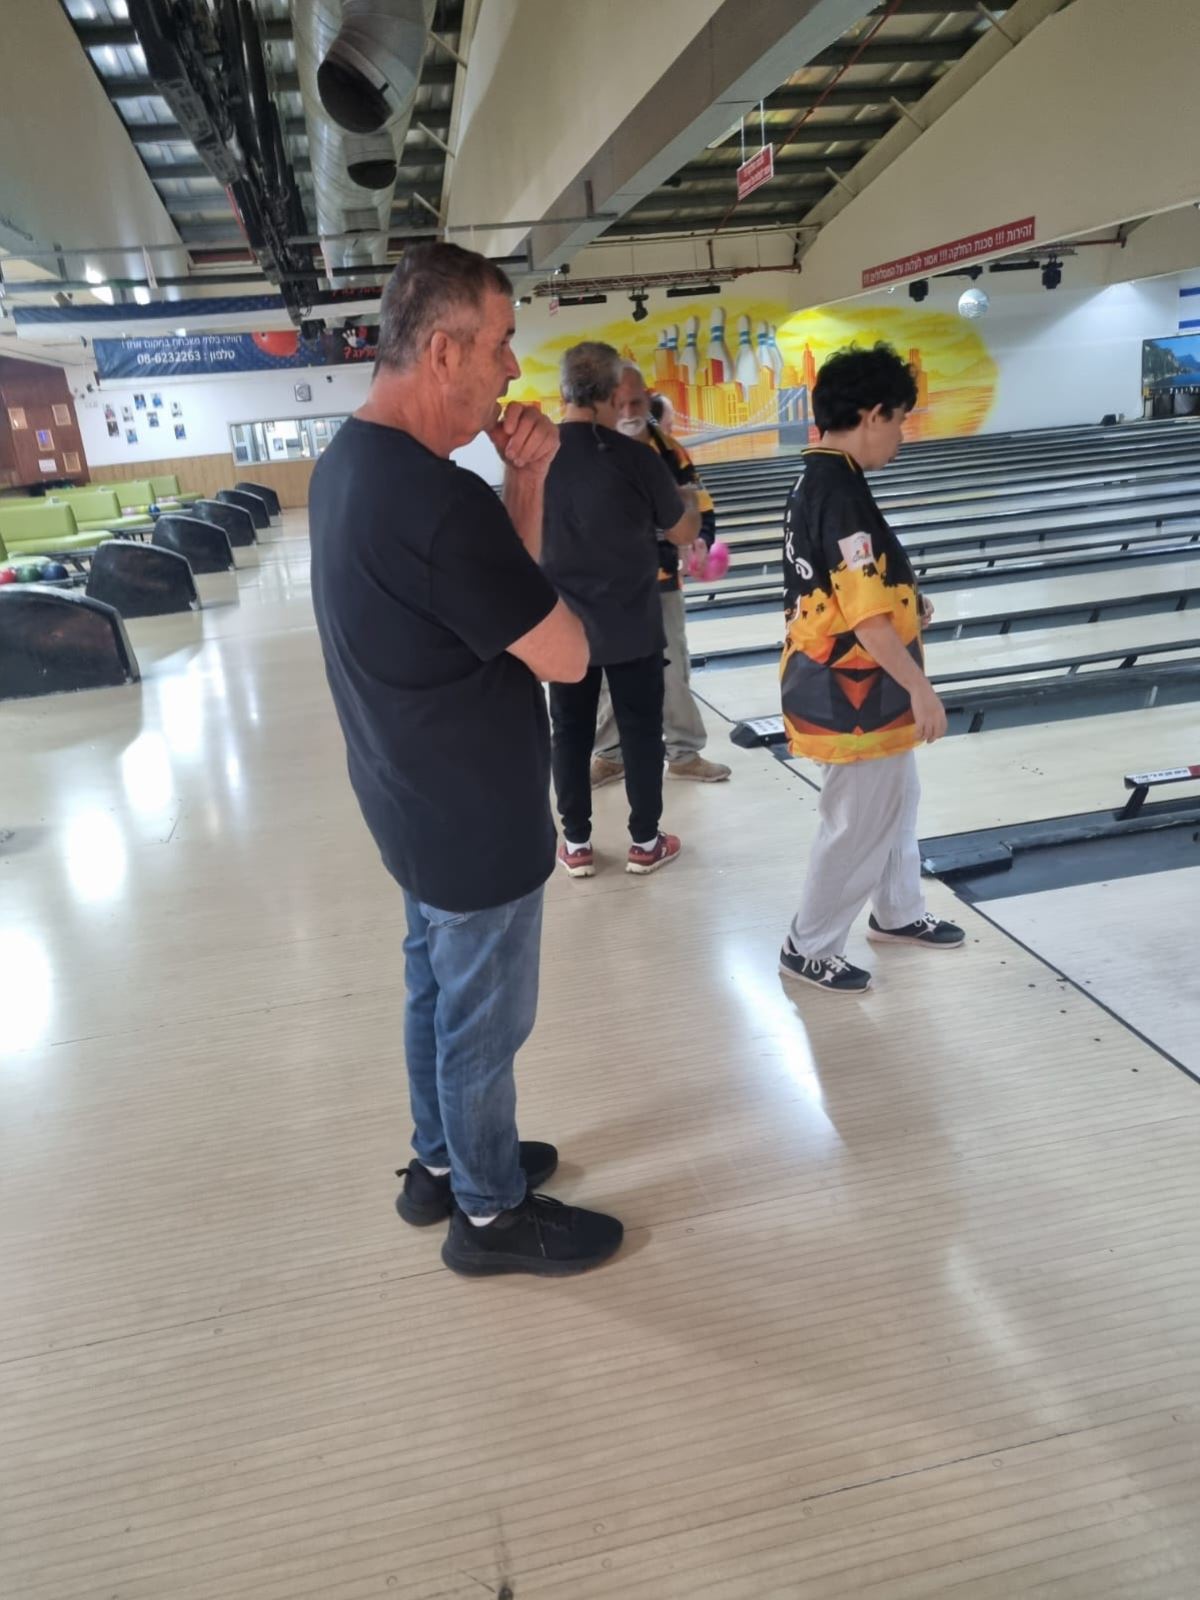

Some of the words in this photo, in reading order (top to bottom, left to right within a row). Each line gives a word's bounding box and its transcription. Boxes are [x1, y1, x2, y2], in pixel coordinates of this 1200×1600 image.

[1007, 224, 1033, 242] זהירות
[948, 242, 972, 260] החלקה
[974, 236, 993, 252] סכנת
[137, 350, 201, 365] 08-6232263
[210, 349, 235, 363] טלפון
